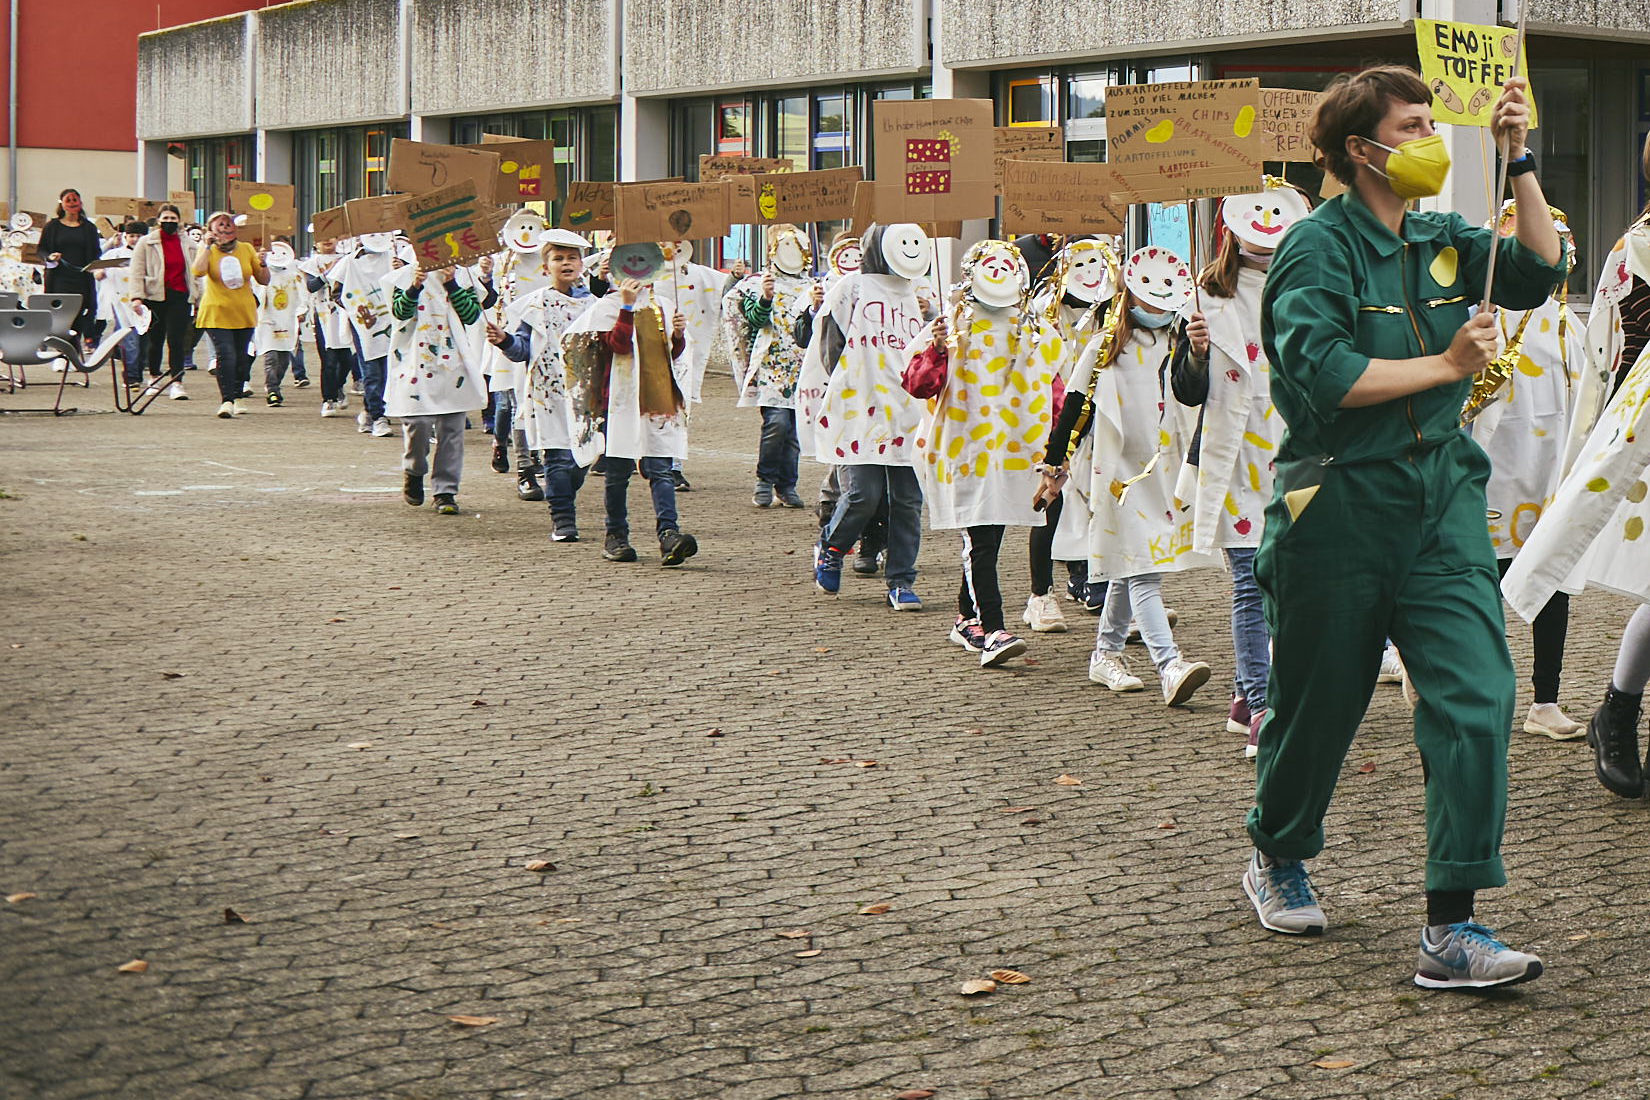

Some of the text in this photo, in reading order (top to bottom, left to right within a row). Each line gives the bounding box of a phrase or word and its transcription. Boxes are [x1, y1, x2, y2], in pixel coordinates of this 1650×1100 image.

[1107, 80, 1252, 98] AUS KARTOFFELN KANN MAN
[1133, 95, 1145, 106] SO
[1152, 94, 1173, 103] VIEL
[1192, 109, 1230, 121] CHIPS
[1111, 116, 1152, 150] POMMES
[1174, 117, 1261, 169] BRATKARTOFFELN
[1186, 185, 1260, 197] KARTOFFELBREI
